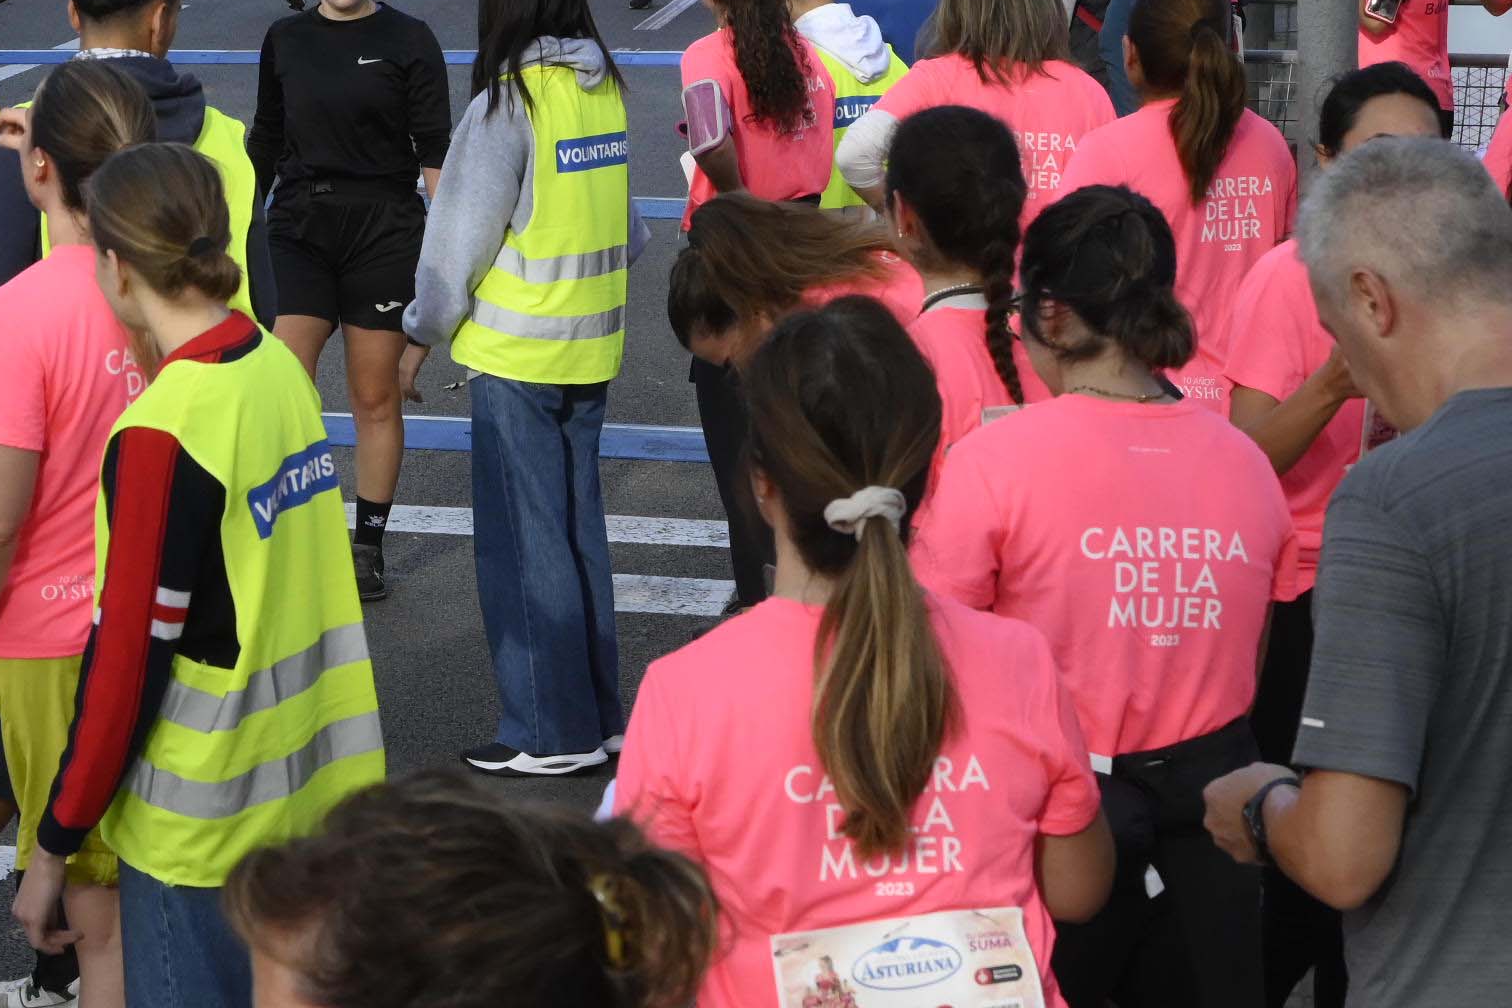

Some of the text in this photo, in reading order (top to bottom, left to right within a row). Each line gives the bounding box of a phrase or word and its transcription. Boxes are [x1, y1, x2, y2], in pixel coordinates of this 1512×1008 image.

[1033, 152, 1058, 170] LA
[1206, 199, 1258, 222] DE LA
[1201, 219, 1260, 243] MUJER
[1080, 526, 1249, 564] CARRERA
[1115, 561, 1219, 595] DE LA
[1107, 596, 1223, 630] MUJER
[1150, 634, 1180, 647] 2023
[875, 881, 915, 897] 2023
[969, 936, 1012, 953] SUMA
[862, 955, 954, 981] ASTURIANA
